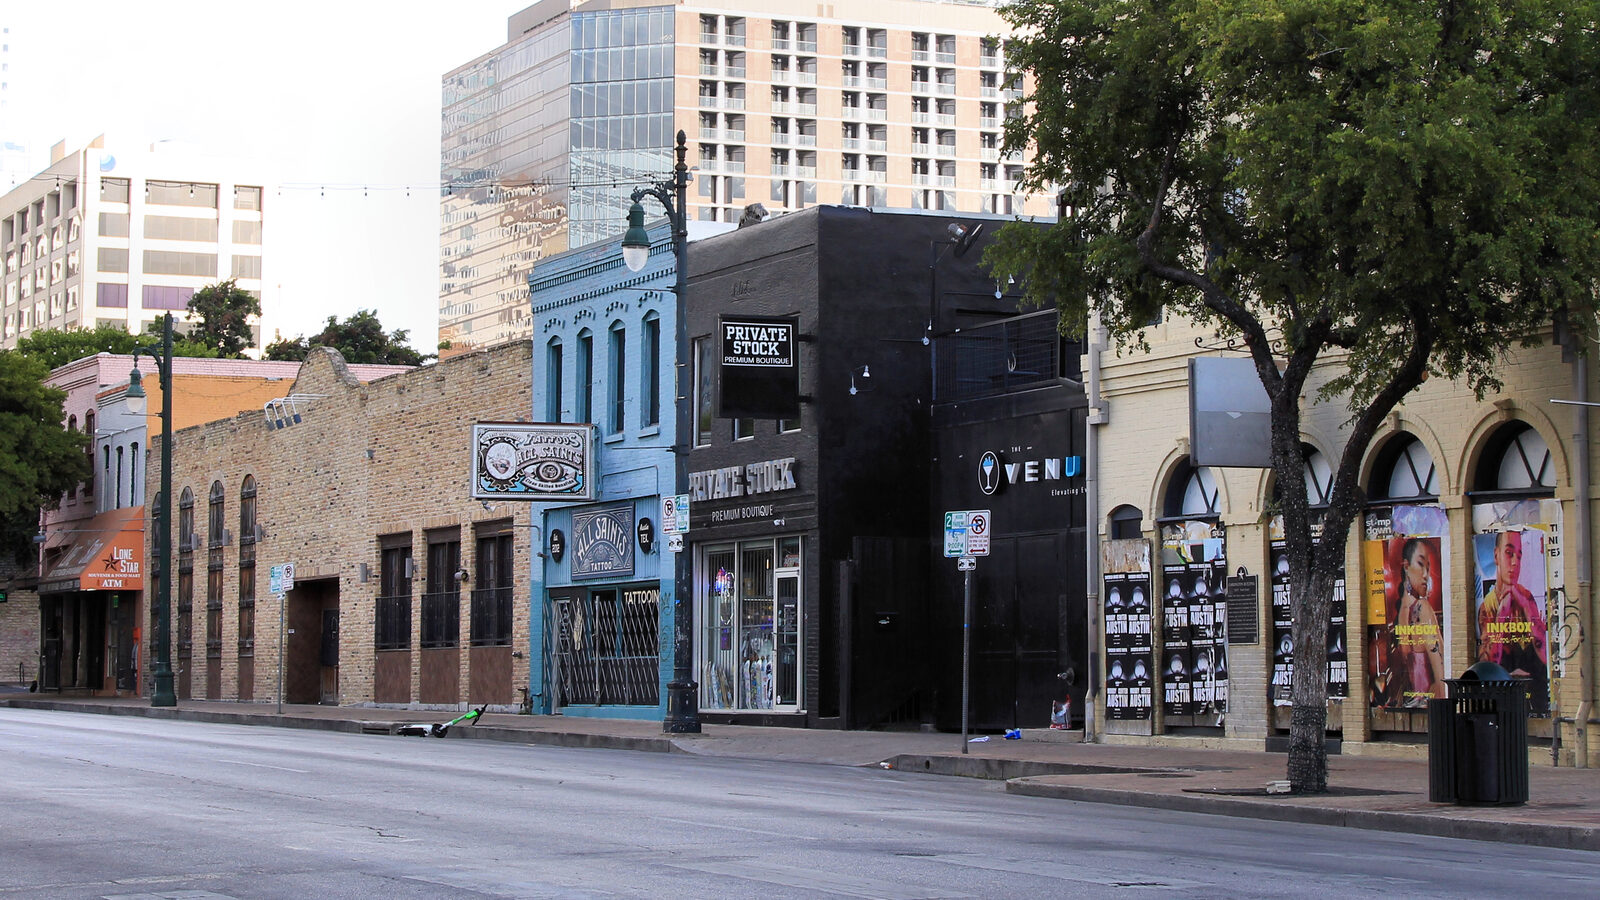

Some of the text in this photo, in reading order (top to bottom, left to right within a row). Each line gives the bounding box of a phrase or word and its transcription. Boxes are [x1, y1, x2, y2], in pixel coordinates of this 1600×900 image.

[726, 326, 787, 341] PRIVATE
[733, 341, 780, 356] STOCK
[516, 446, 582, 466] ALL SAINTS
[746, 458, 796, 495] STOCK
[1004, 456, 1080, 484] VENU
[712, 505, 773, 522] PREMIUM BOUTIQUE
[946, 515, 952, 527] 2
[578, 518, 626, 560] ALL SAINTS
[114, 546, 133, 560] LONE
[120, 560, 138, 572] STAR
[591, 562, 612, 571] TATTOO
[1190, 612, 1213, 625] AUSTIN
[1106, 621, 1127, 634] AUSTIN
[1129, 621, 1150, 634] AUSTIN
[1395, 625, 1437, 635] INKBOX
[1487, 622, 1531, 632] INKBOX
[1107, 694, 1128, 707] AUSTIN
[1130, 694, 1151, 707] AUSTIN
[1165, 690, 1190, 703] AUSTIN
